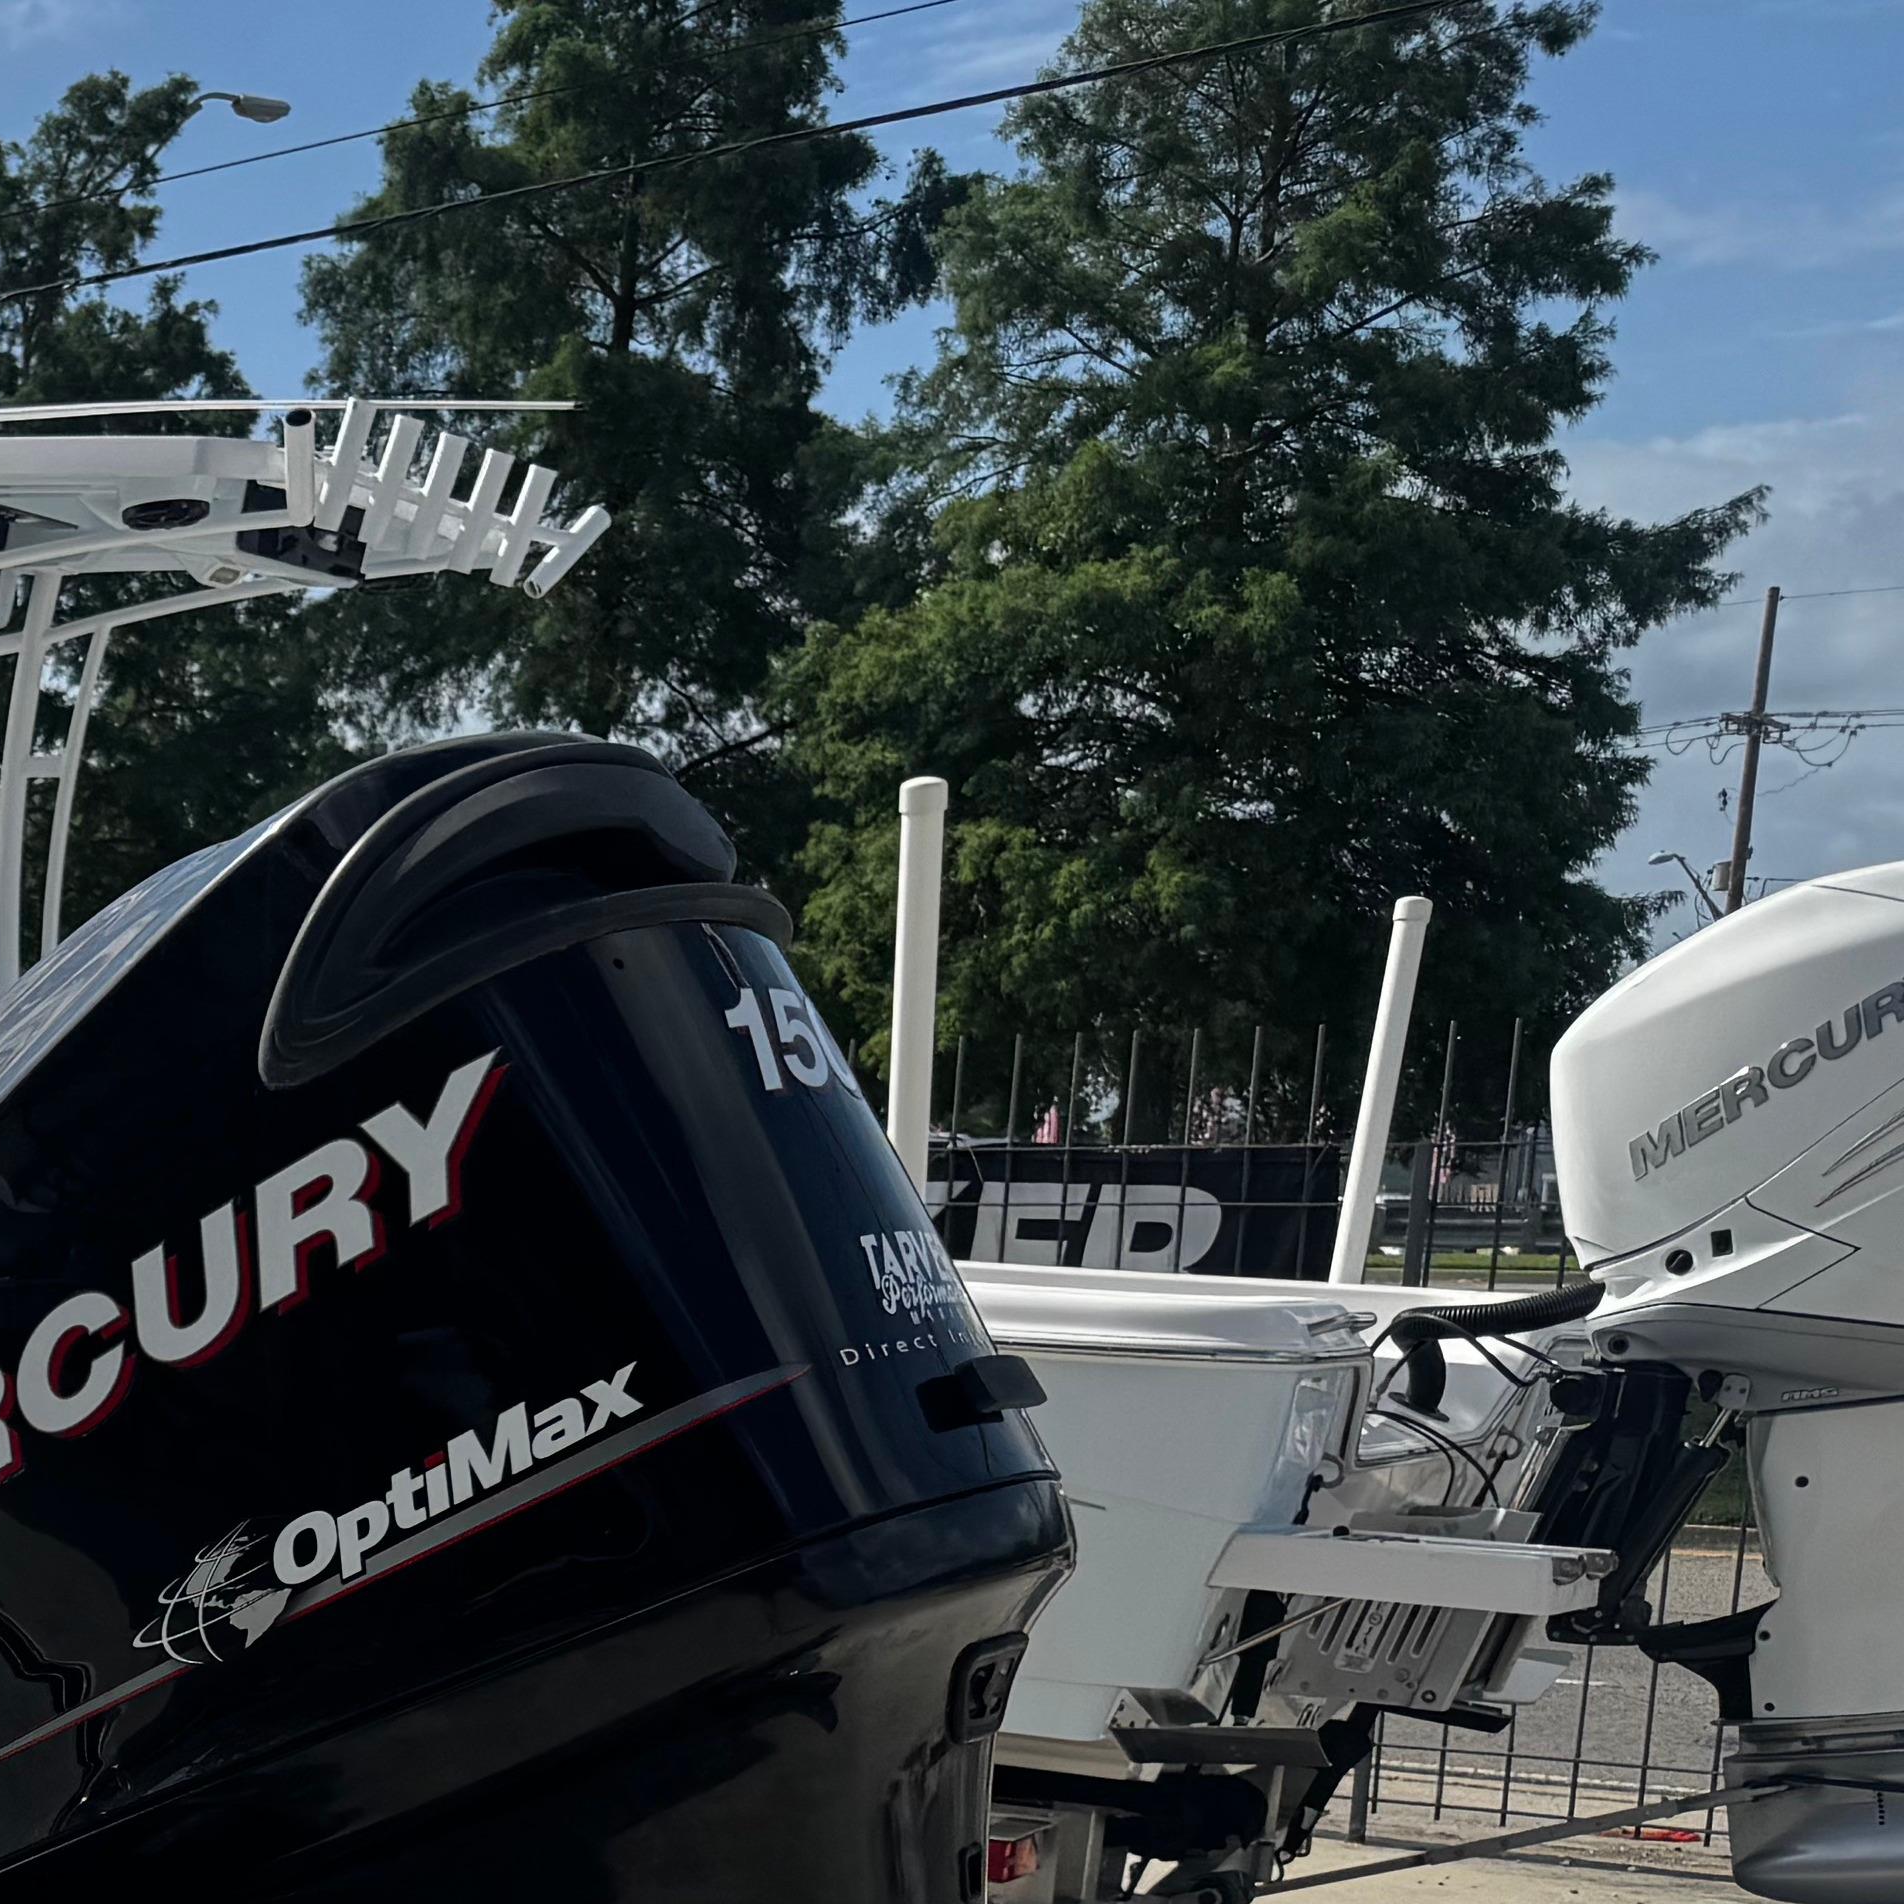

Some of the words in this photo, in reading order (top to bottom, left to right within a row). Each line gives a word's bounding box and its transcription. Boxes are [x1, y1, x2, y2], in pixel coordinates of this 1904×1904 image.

[1627, 977, 1904, 1180] MERCUR
[859, 1230, 955, 1290] TARVE
[839, 1332, 938, 1367] Direct
[272, 1361, 645, 1588] OptiMax
